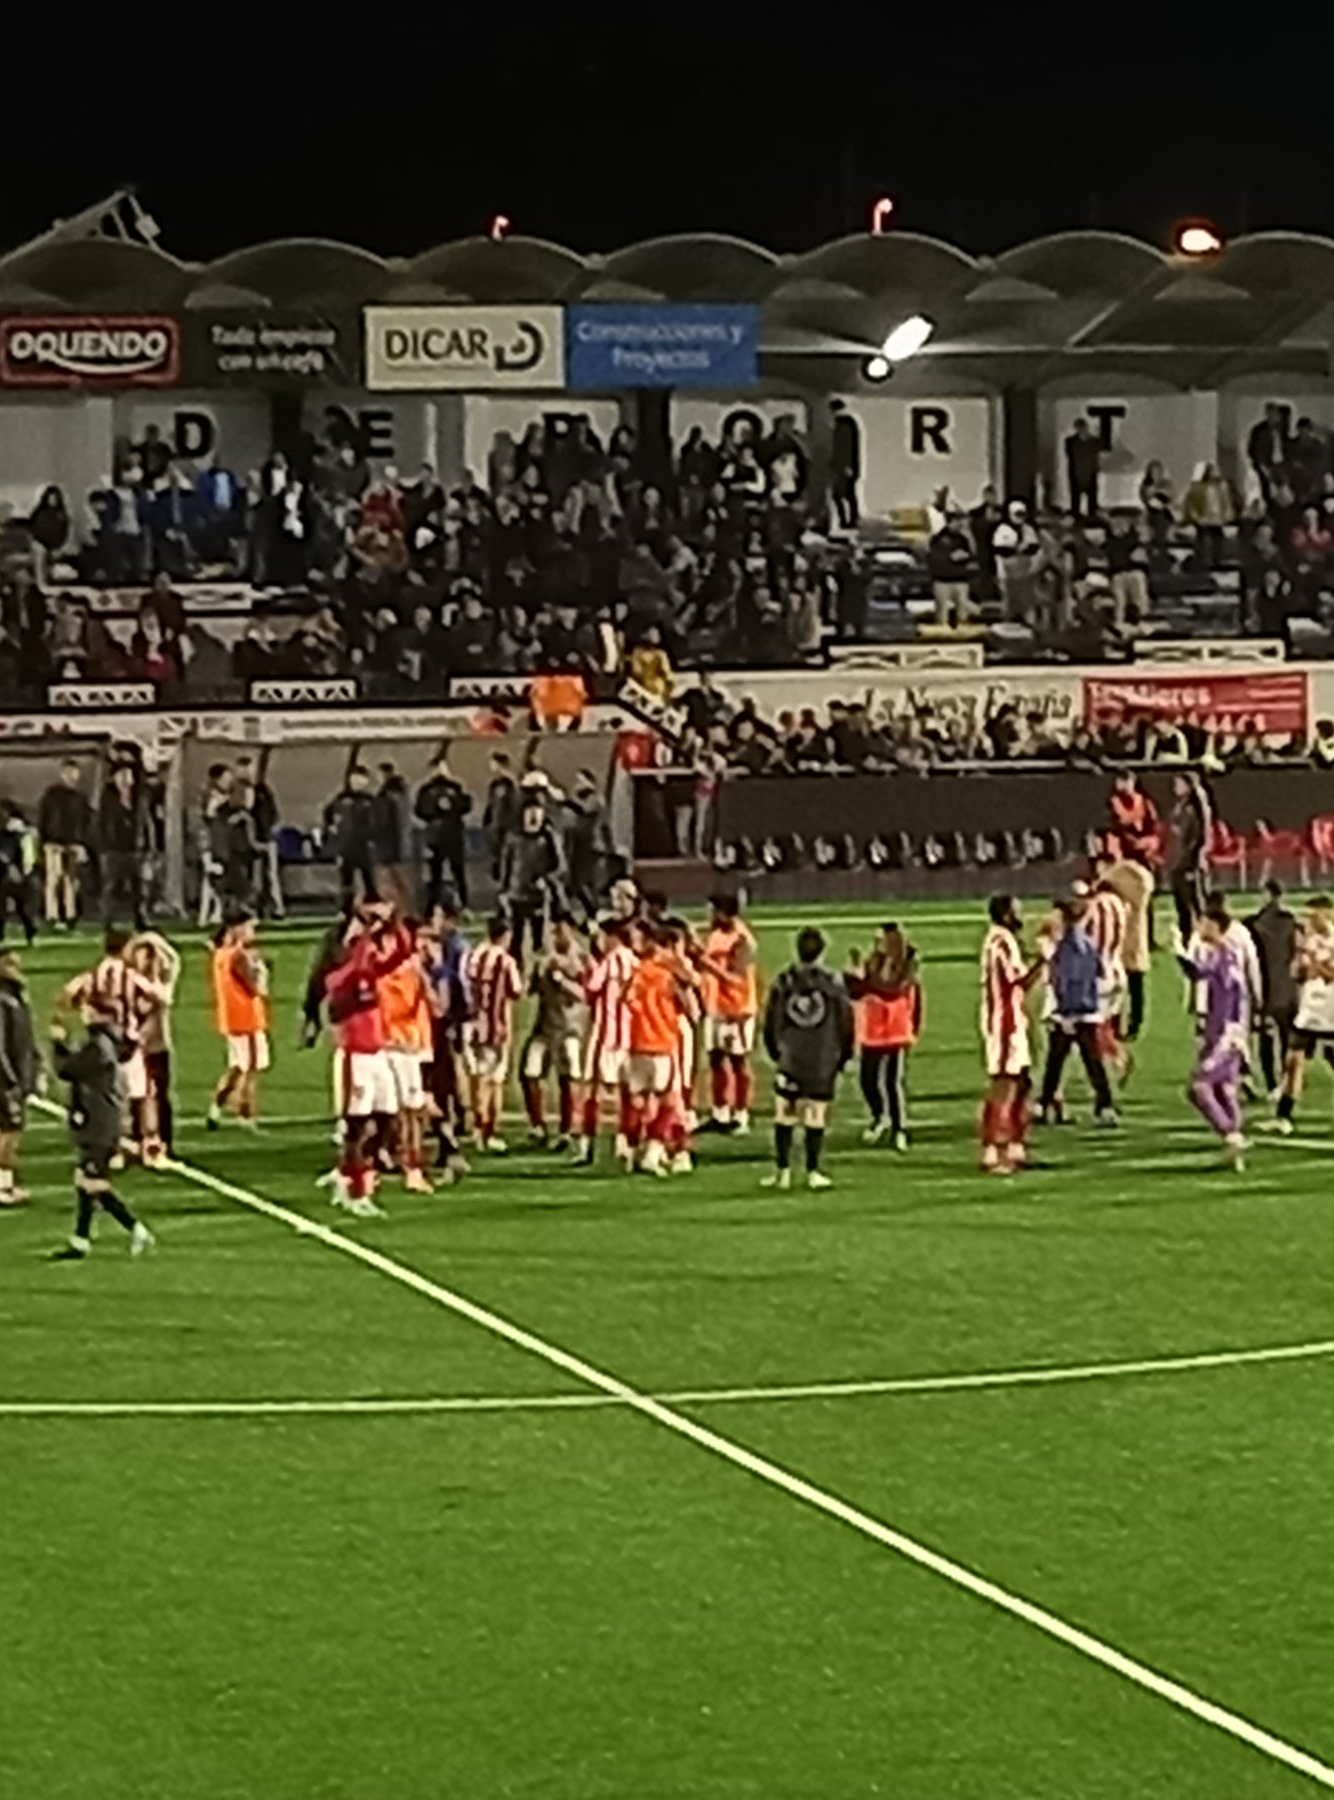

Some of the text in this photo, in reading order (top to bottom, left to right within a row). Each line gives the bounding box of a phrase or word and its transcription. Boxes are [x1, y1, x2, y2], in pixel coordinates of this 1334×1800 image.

[10, 330, 167, 374] OQUENDO
[384, 328, 489, 360] DICAR
[911, 407, 951, 454] R
